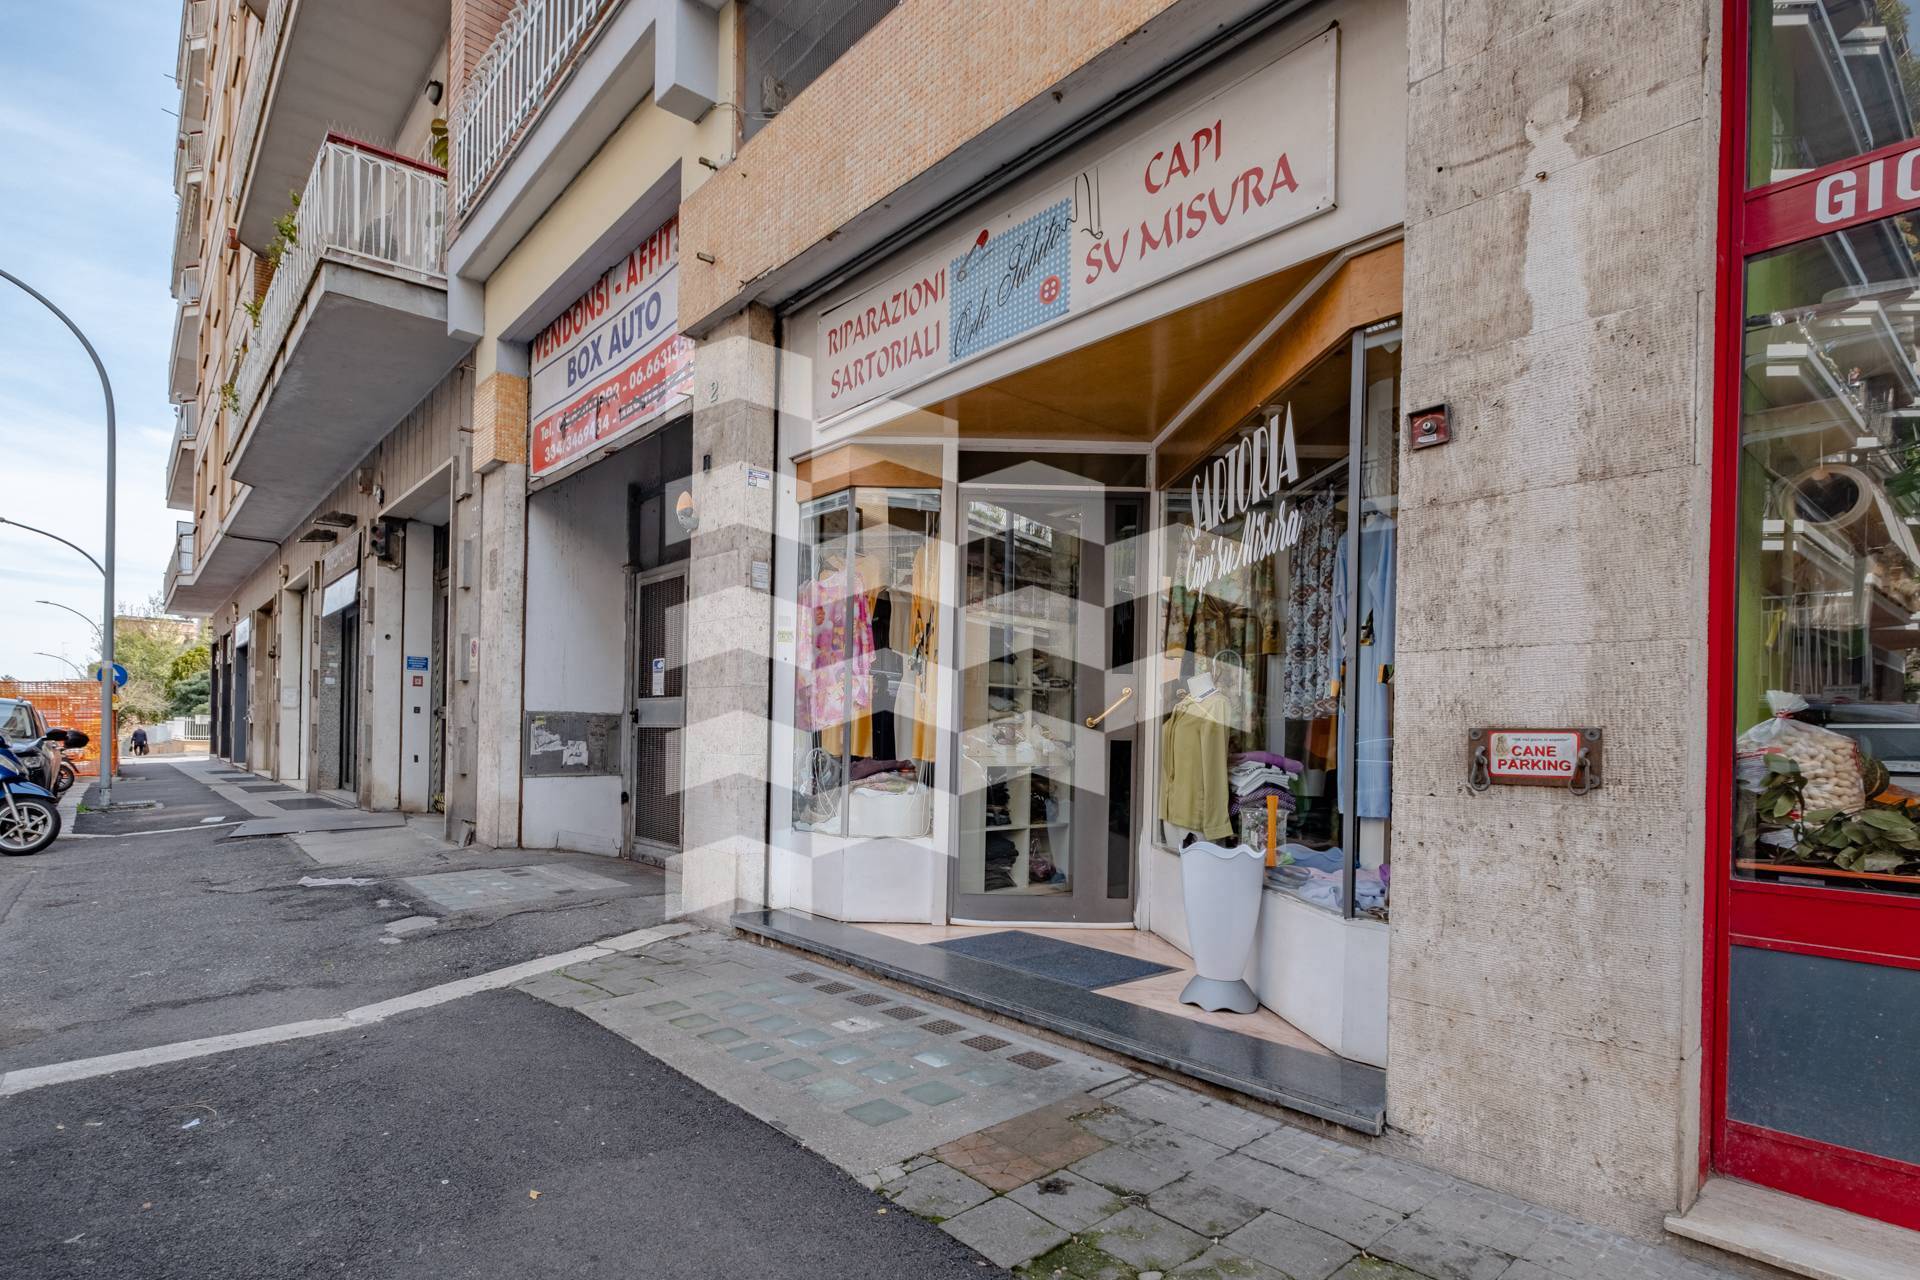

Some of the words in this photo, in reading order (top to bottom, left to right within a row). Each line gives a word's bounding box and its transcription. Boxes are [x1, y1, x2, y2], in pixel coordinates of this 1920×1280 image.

[1145, 119, 1222, 194] CAPI
[997, 216, 1063, 308] Subito
[1086, 228, 1129, 285] SU
[1140, 152, 1299, 260] MISURA
[534, 274, 610, 363] VENDONSI
[626, 215, 679, 293] AFFIT
[827, 268, 945, 357] RIPARAZIONI
[568, 334, 603, 388] BOX
[608, 291, 662, 360] AUTO
[831, 320, 941, 399] SARTORIALI
[1191, 400, 1299, 542] SARTORIA
[1186, 540, 1216, 603] Capi
[1498, 759, 1571, 771] PARKING
[1511, 745, 1557, 757] CANE
